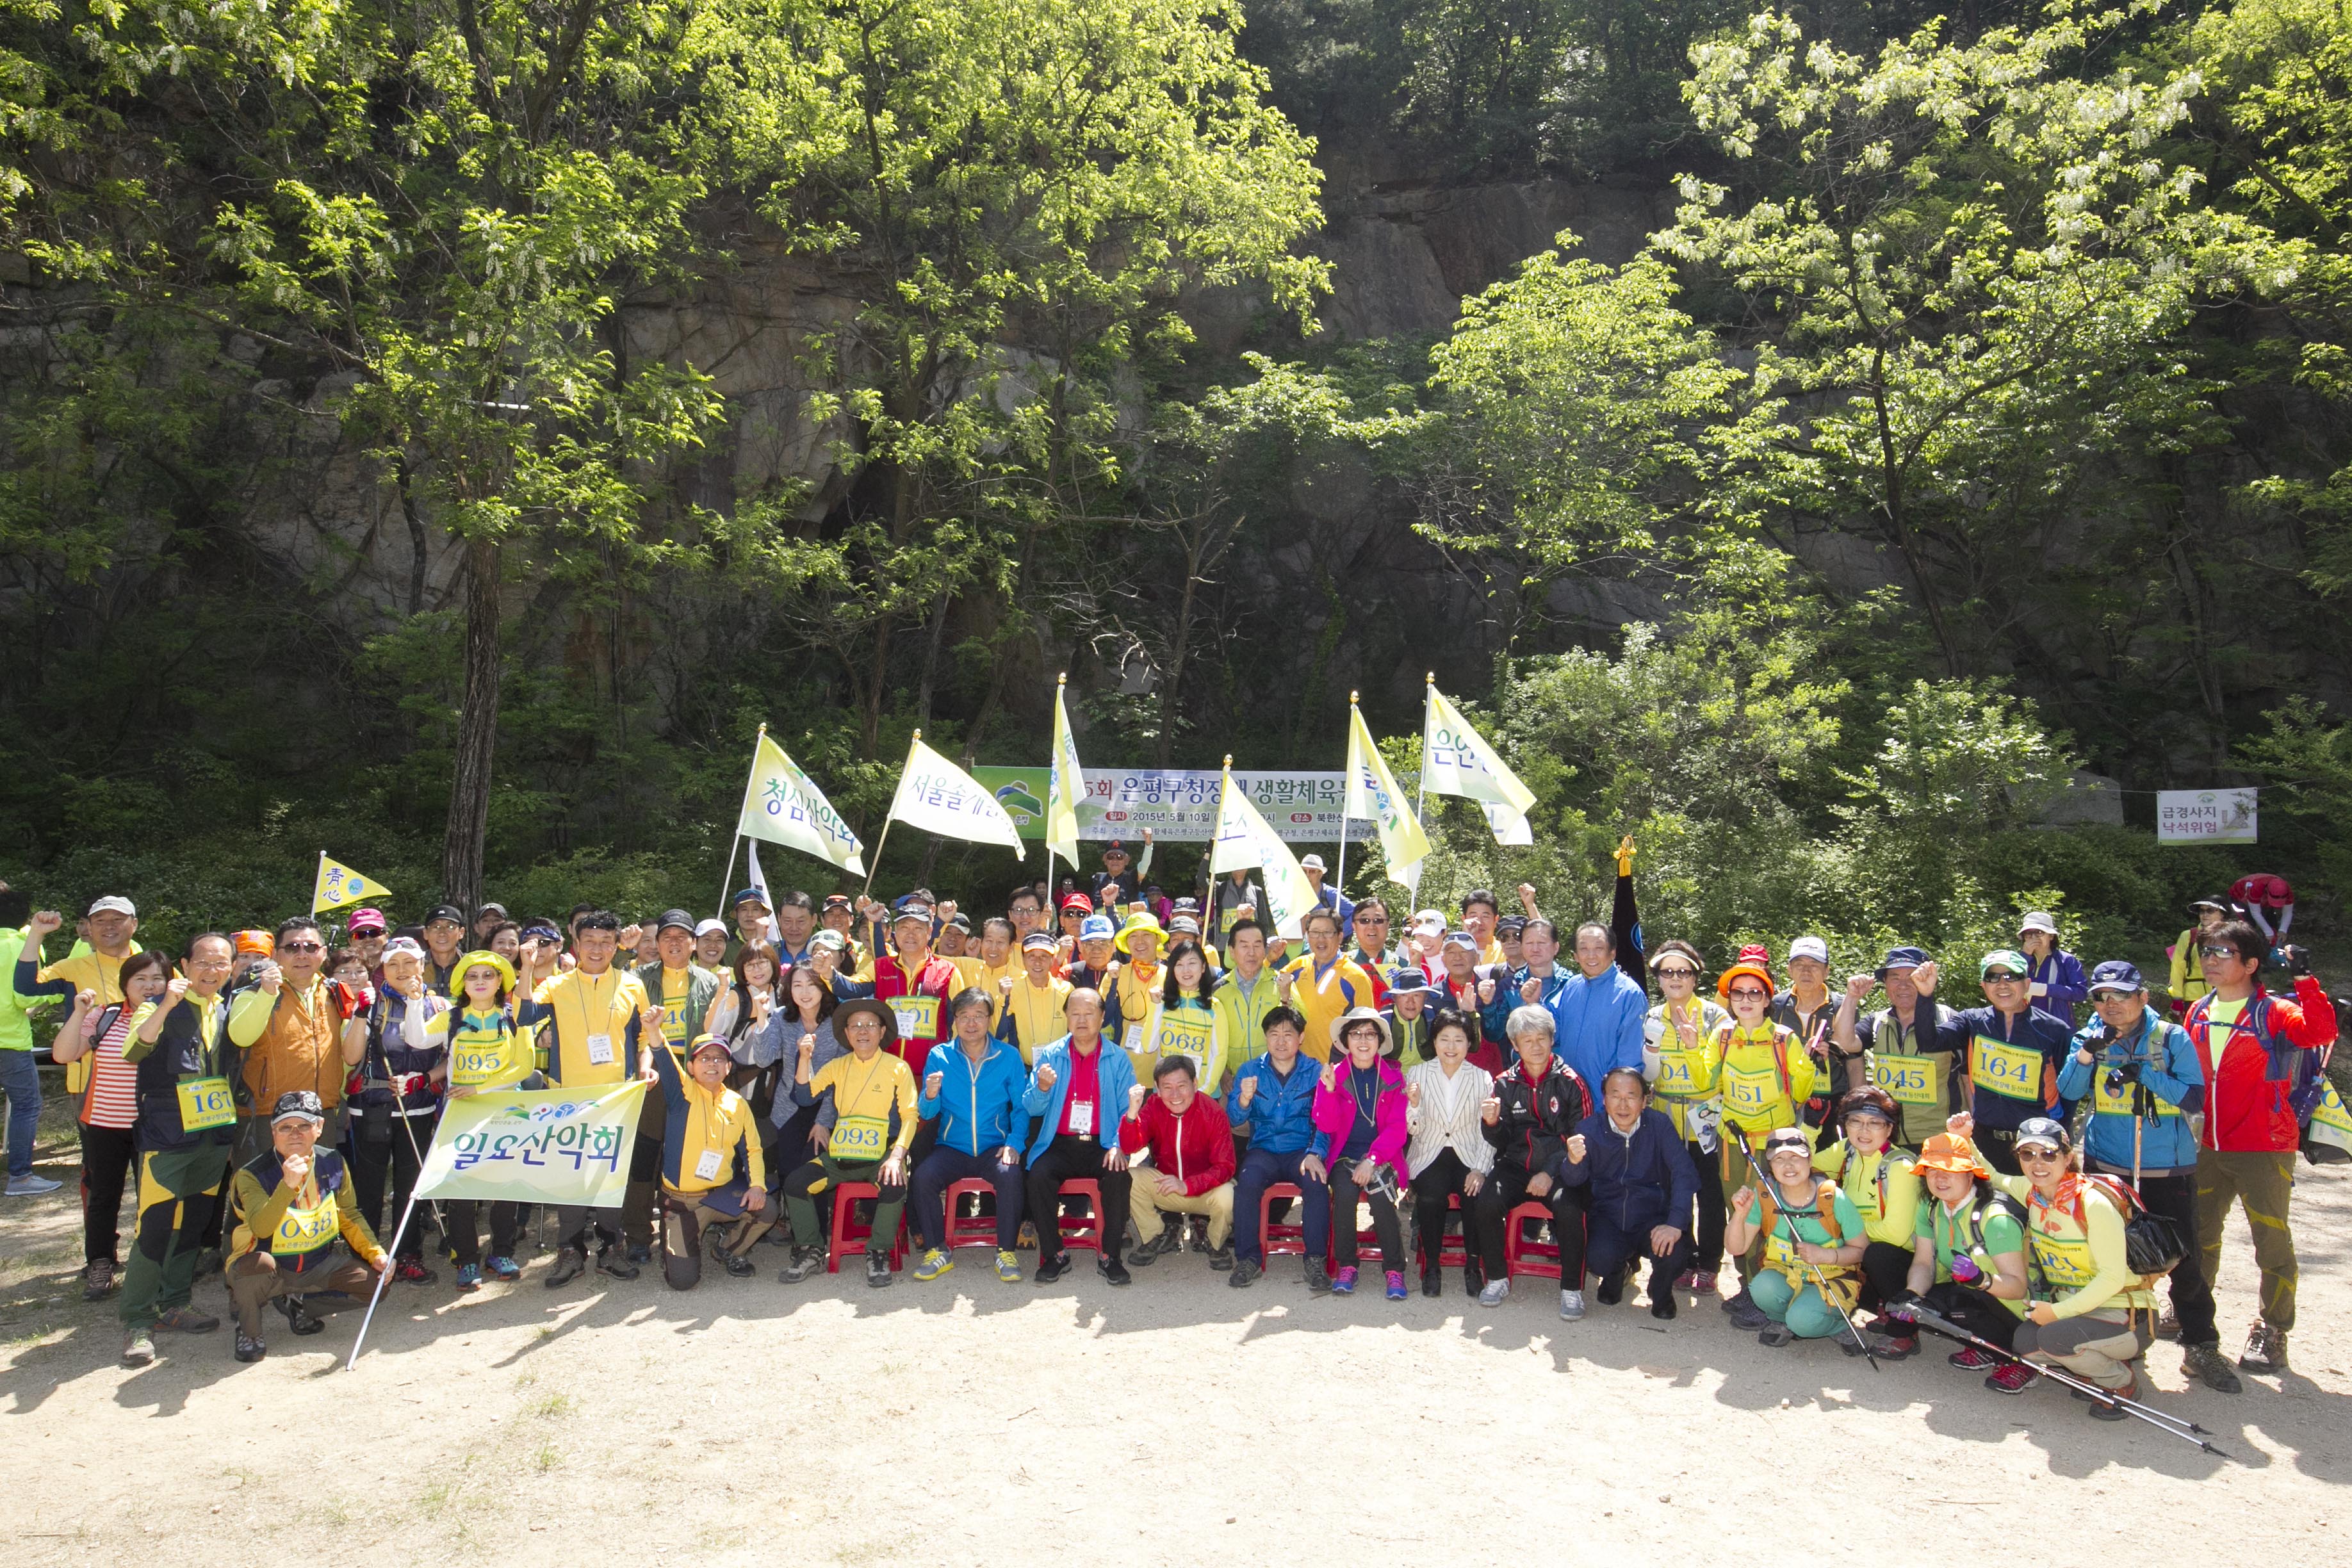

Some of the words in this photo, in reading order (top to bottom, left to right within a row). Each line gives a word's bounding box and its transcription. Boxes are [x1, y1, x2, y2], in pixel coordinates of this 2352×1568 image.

[1132, 813, 1165, 822] 2015년
[1170, 813, 1185, 822] 5월
[1189, 813, 1210, 822] 10일
[2162, 806, 2216, 819] 급경사지
[2162, 821, 2217, 833] 낙석위험
[1161, 1029, 1205, 1052] 068
[455, 1052, 501, 1071] 095
[1980, 1052, 2030, 1082] 164
[1877, 1066, 1925, 1089] 045
[192, 1091, 231, 1113] 167
[1731, 1081, 1764, 1103] 151
[453, 1122, 624, 1173] 일요산악회
[834, 1127, 879, 1146] 093
[281, 1211, 332, 1239] 038
